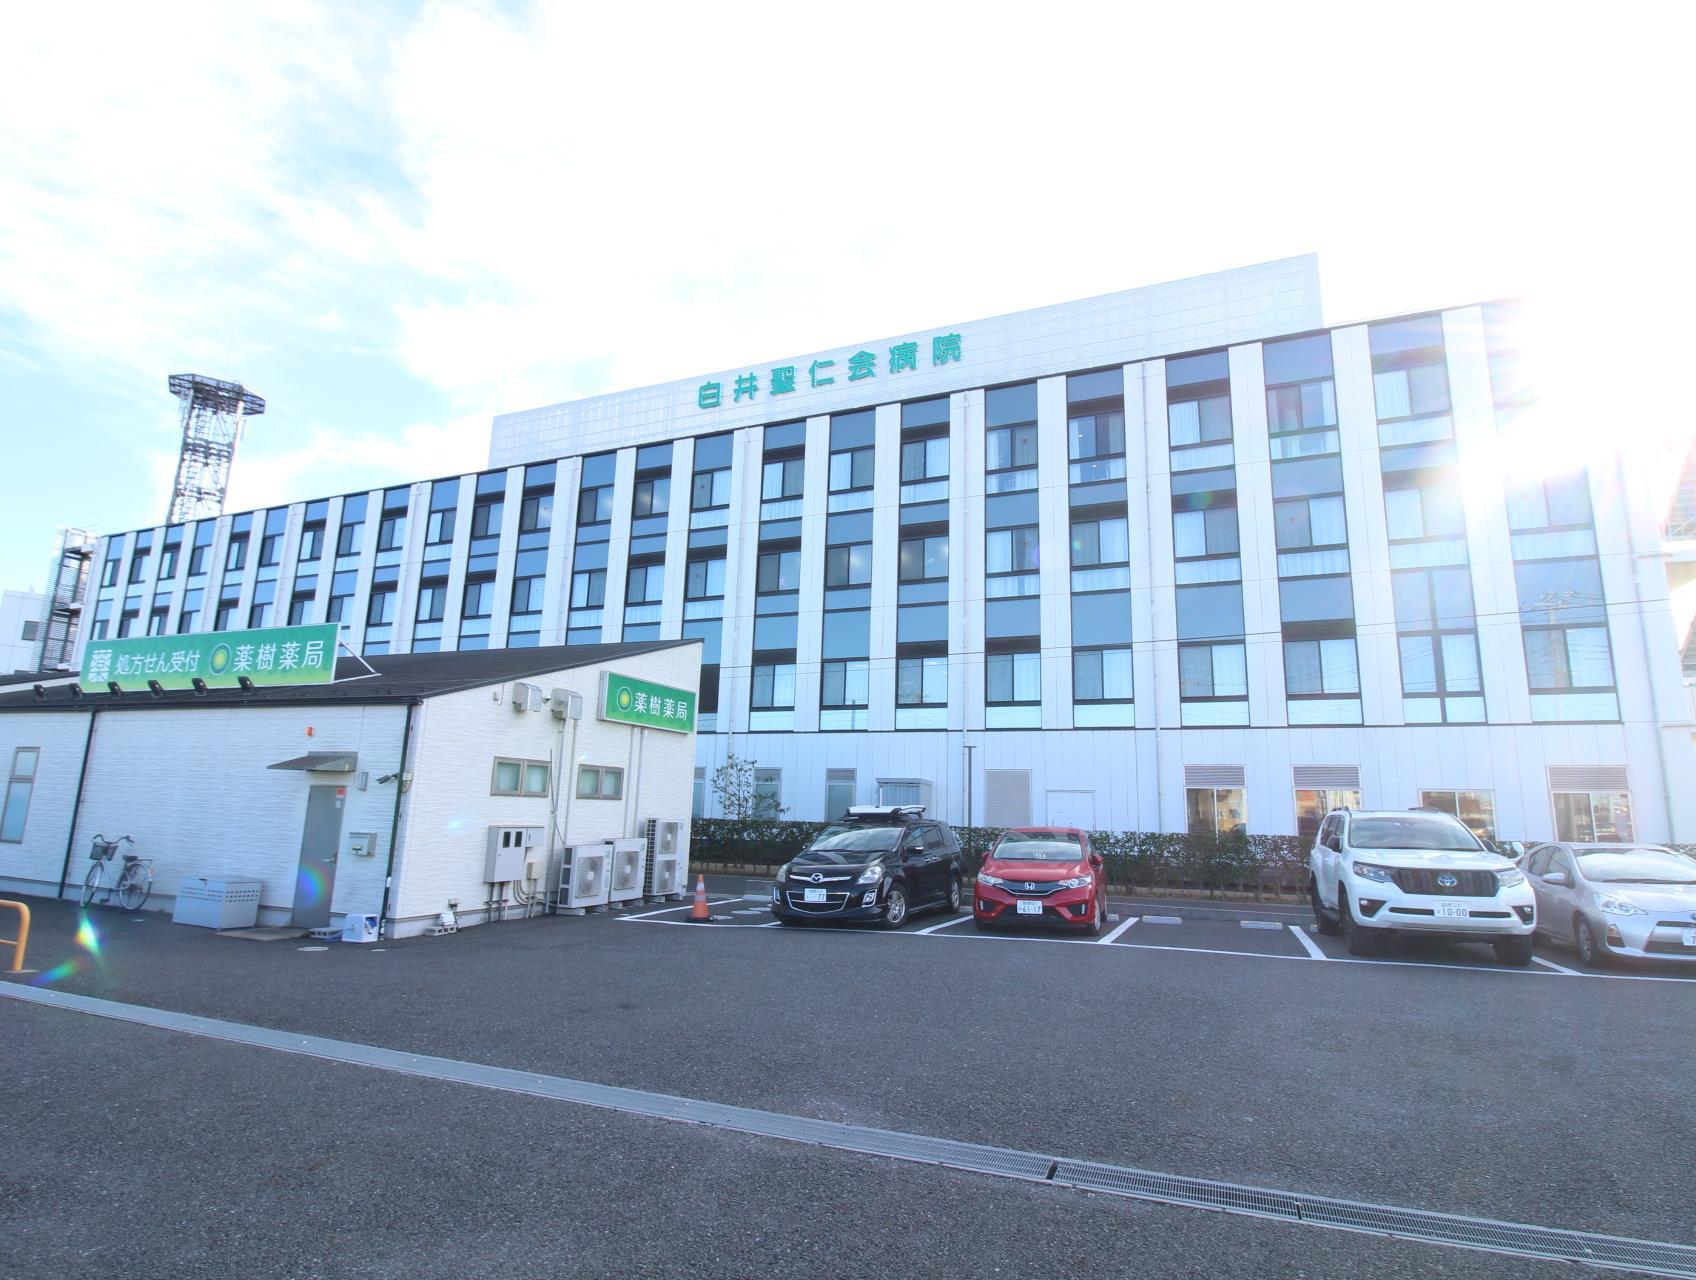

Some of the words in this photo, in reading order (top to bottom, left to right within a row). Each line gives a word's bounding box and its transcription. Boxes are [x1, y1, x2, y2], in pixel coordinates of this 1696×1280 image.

[698, 333, 961, 409] 白井聖仁会病院
[114, 649, 201, 675] 処方せん受付
[232, 640, 324, 672] 薬樹薬局
[634, 691, 688, 721] 薬樹薬局
